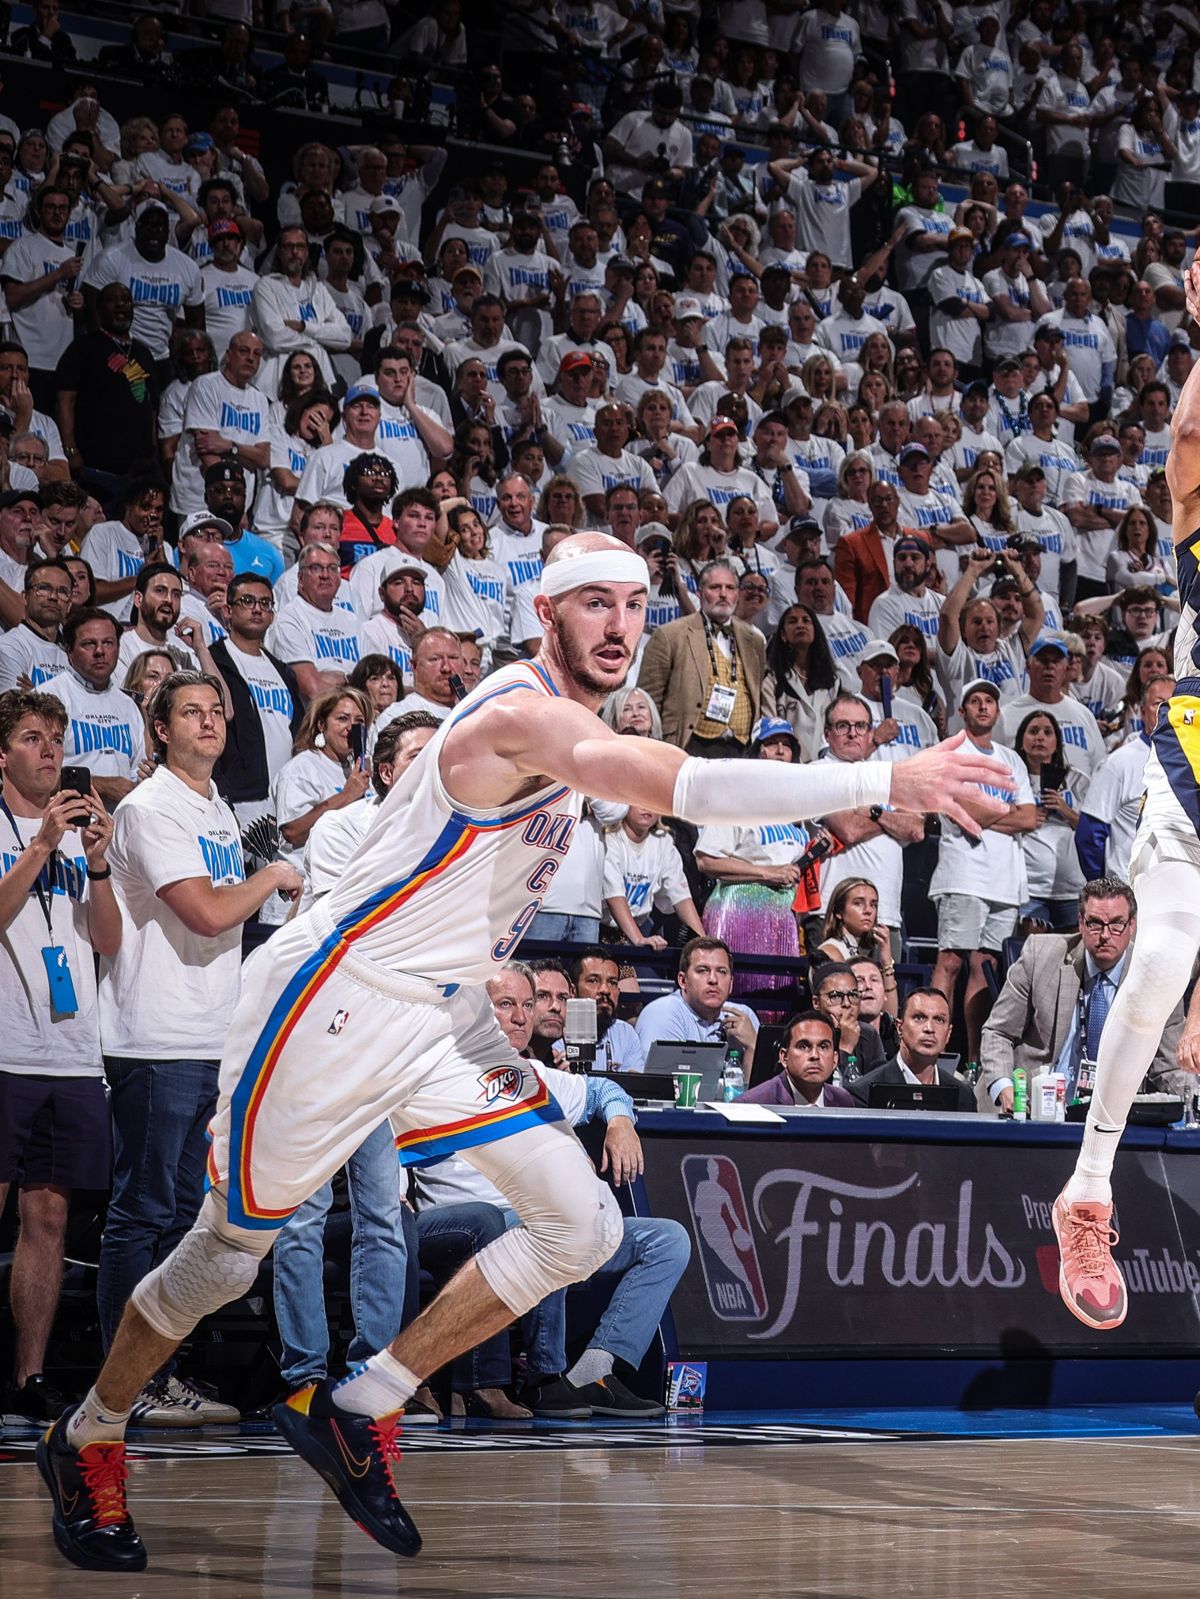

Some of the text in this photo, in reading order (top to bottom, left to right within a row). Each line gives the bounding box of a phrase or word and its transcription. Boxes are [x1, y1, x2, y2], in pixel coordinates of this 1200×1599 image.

[130, 277, 180, 307] THUNDER
[379, 418, 418, 440] THUND
[85, 714, 120, 722] OKLAHOMA
[71, 719, 132, 757] THUNDER
[491, 897, 543, 962] 9
[486, 1071, 515, 1101] OKC
[747, 1169, 1027, 1340] Finals
[1121, 1249, 1200, 1294] uTube
[717, 1289, 748, 1311] NBA
